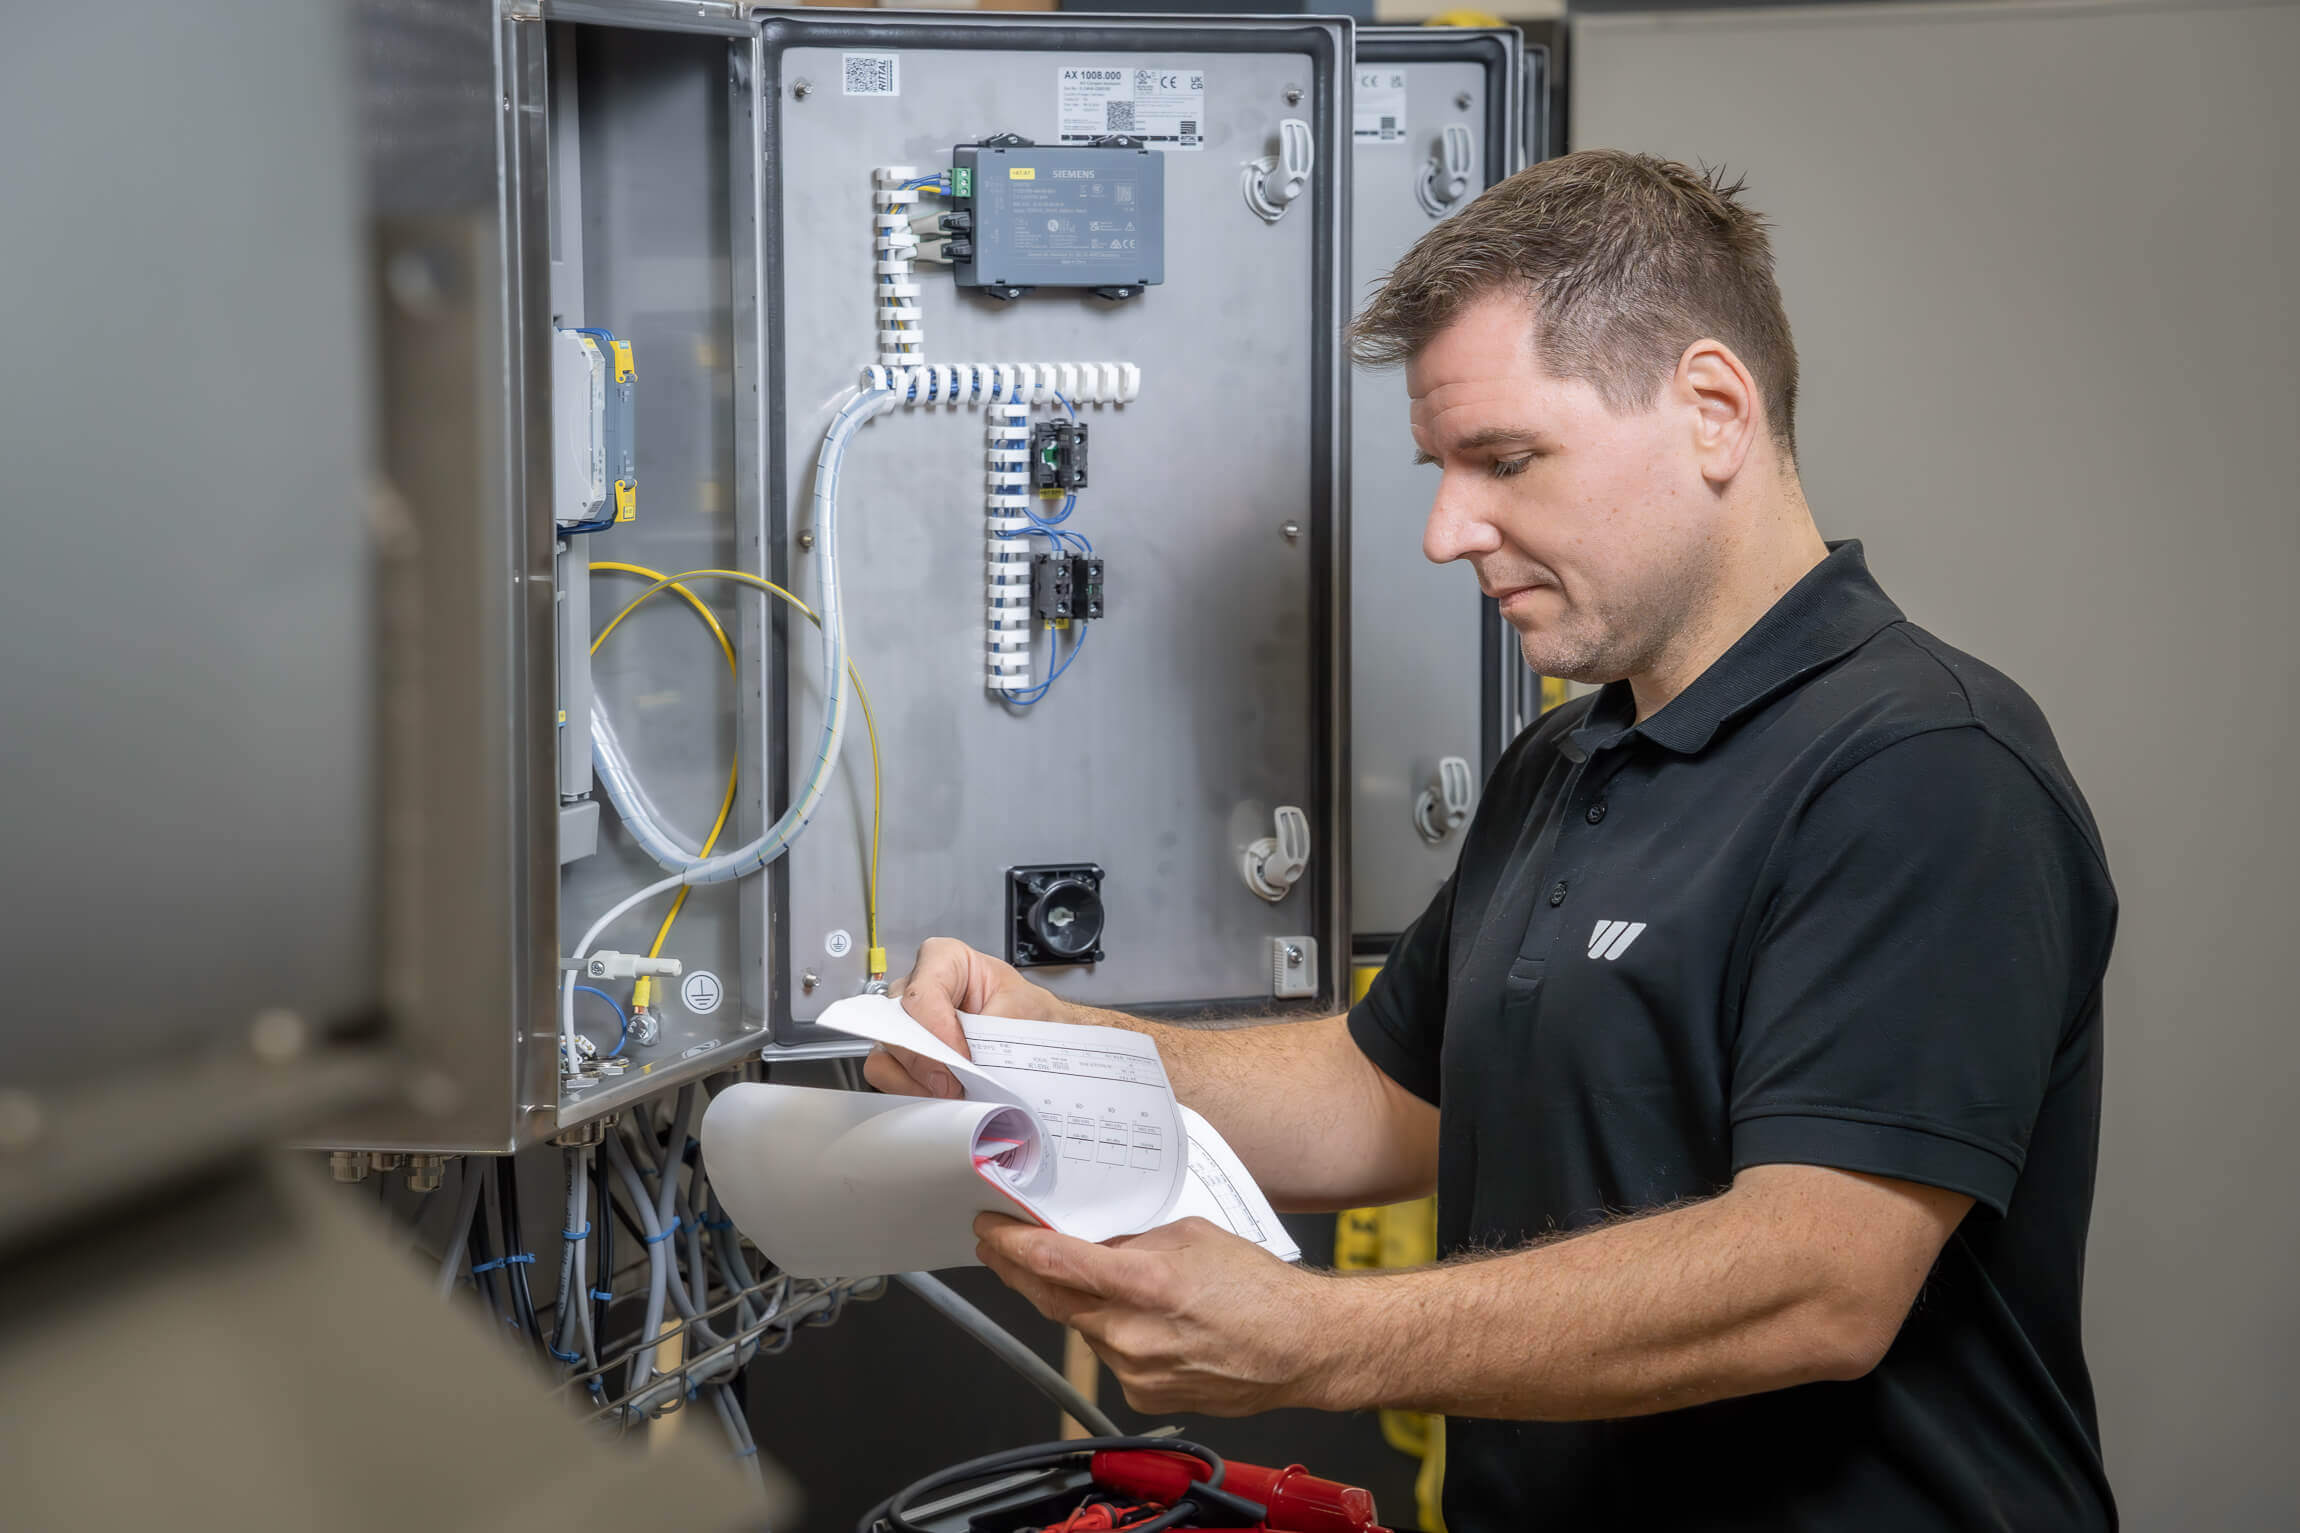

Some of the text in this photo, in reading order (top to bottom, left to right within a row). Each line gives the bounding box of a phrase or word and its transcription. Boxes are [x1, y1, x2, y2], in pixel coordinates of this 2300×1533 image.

[878, 60, 887, 91] RITTAL
[1064, 71, 1122, 80] AX 1008.000
[1052, 169, 1095, 179] SIEMENS
